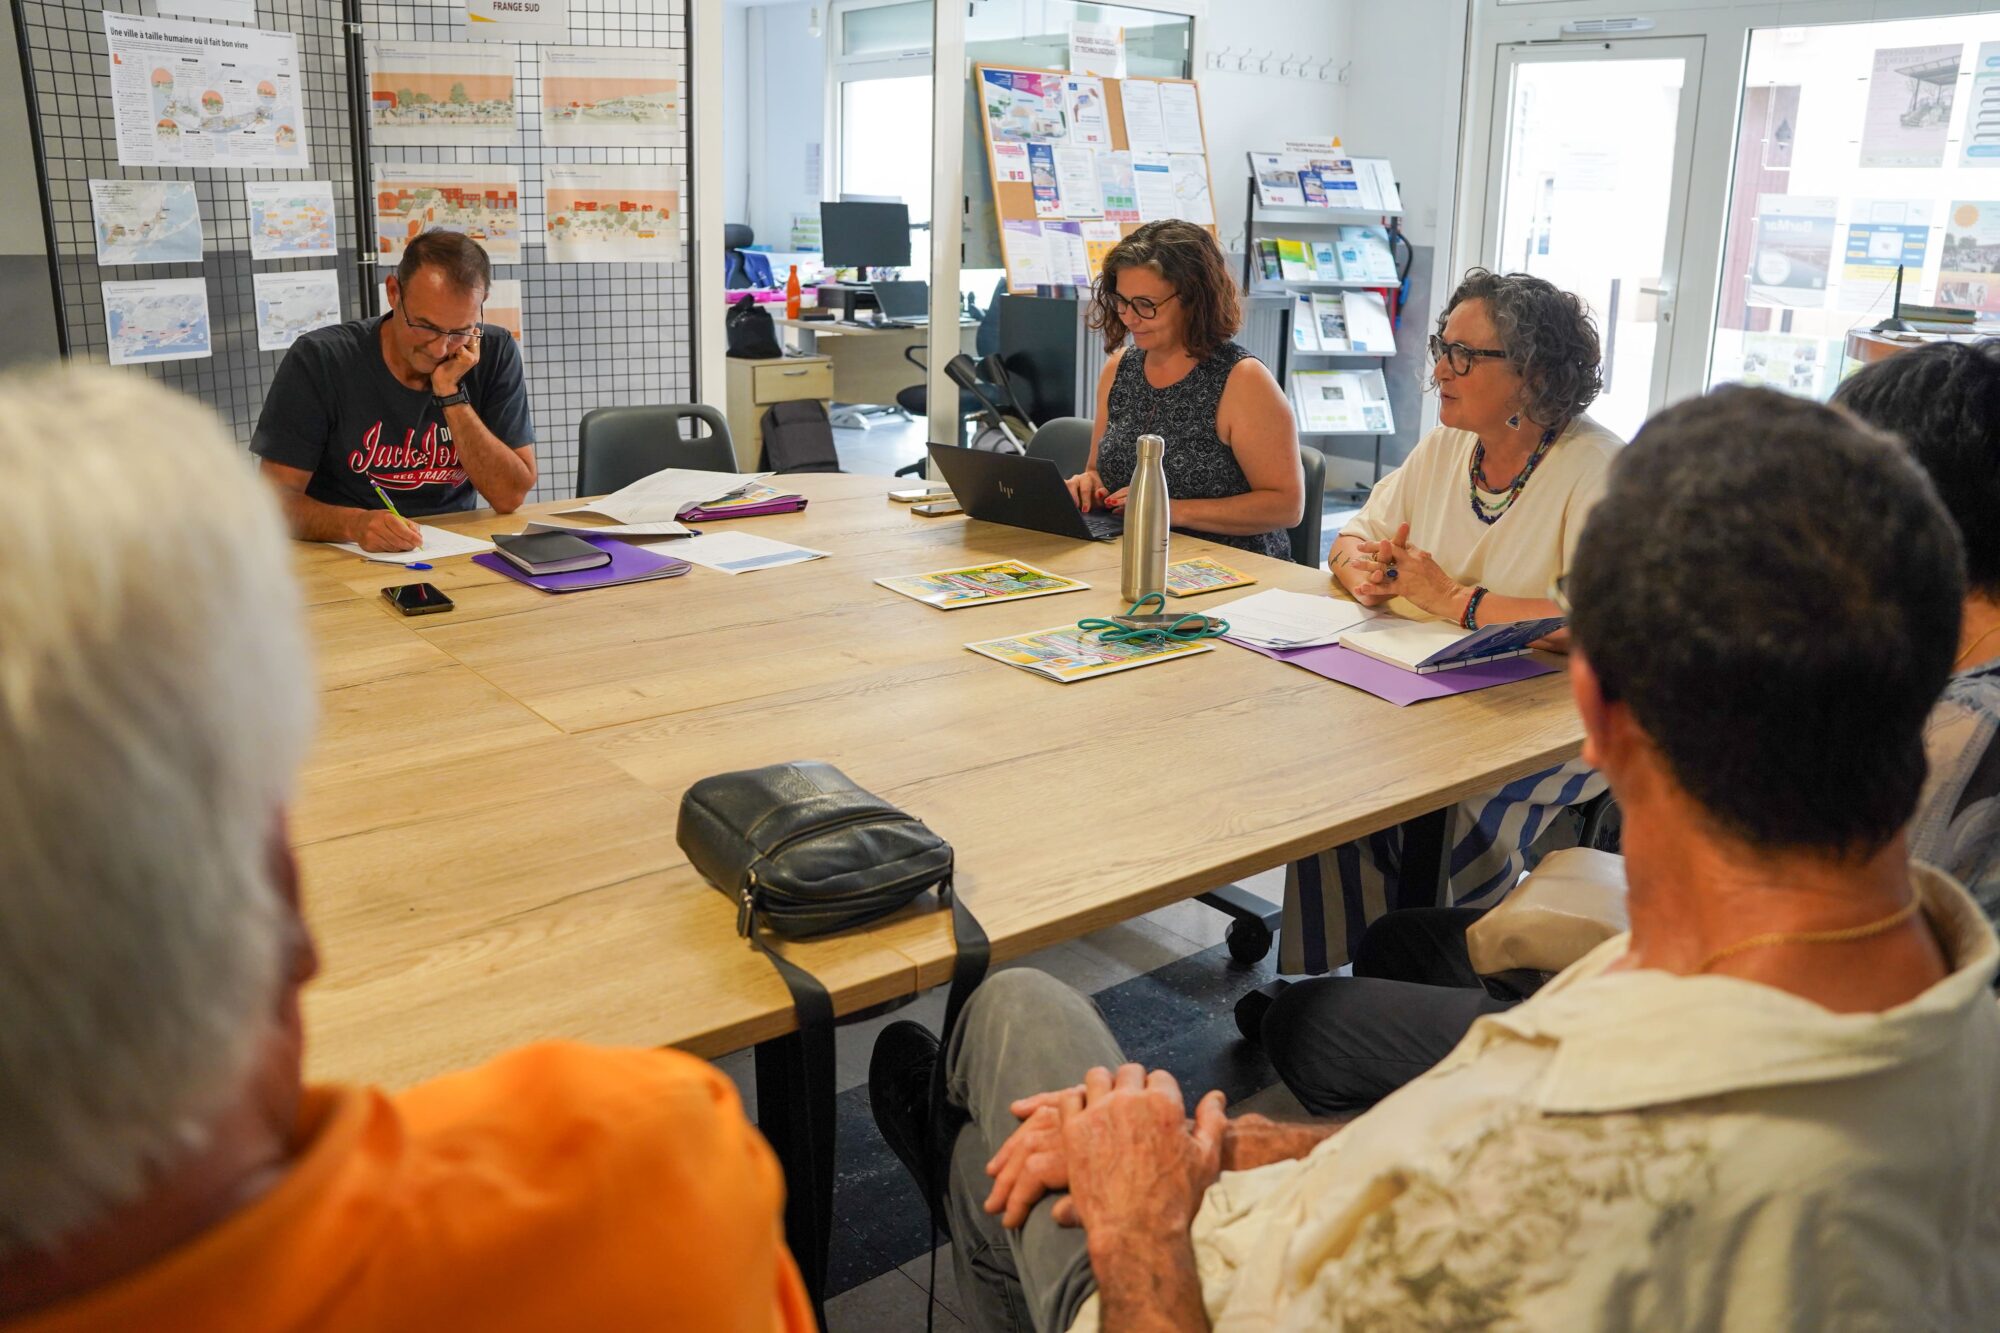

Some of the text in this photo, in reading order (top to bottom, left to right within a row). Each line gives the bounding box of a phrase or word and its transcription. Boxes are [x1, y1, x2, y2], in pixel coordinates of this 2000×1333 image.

[493, 1, 540, 12] FRANGE SUD
[110, 26, 123, 37] Une
[123, 28, 138, 38] ville
[145, 31, 163, 41] taille
[163, 33, 193, 44] humaine
[209, 37, 221, 46] fait
[221, 38, 234, 47] bon
[234, 40, 249, 49] vivre
[348, 420, 420, 474] Jack
